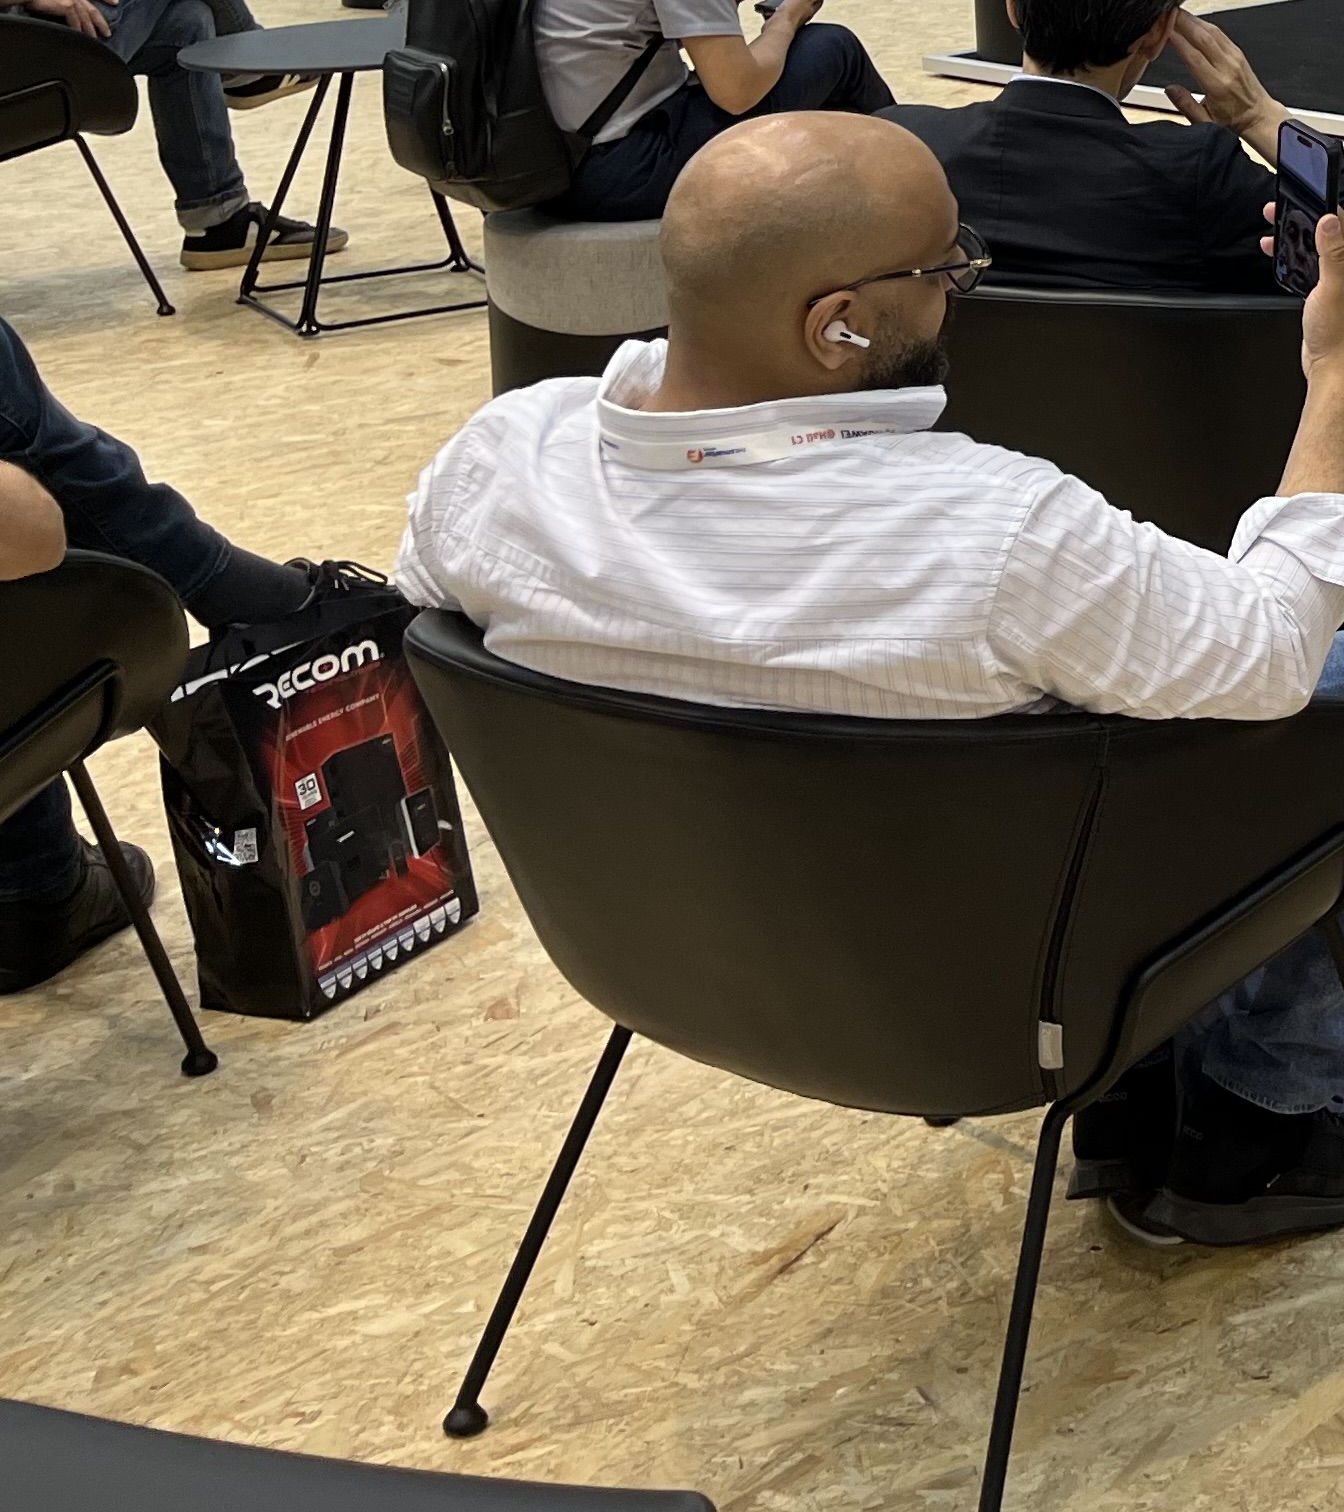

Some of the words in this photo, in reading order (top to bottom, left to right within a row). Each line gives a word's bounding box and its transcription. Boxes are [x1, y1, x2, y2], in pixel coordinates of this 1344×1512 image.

[252, 639, 380, 710] RECOM
[345, 692, 380, 713] COMPANY
[297, 777, 316, 796] 30
